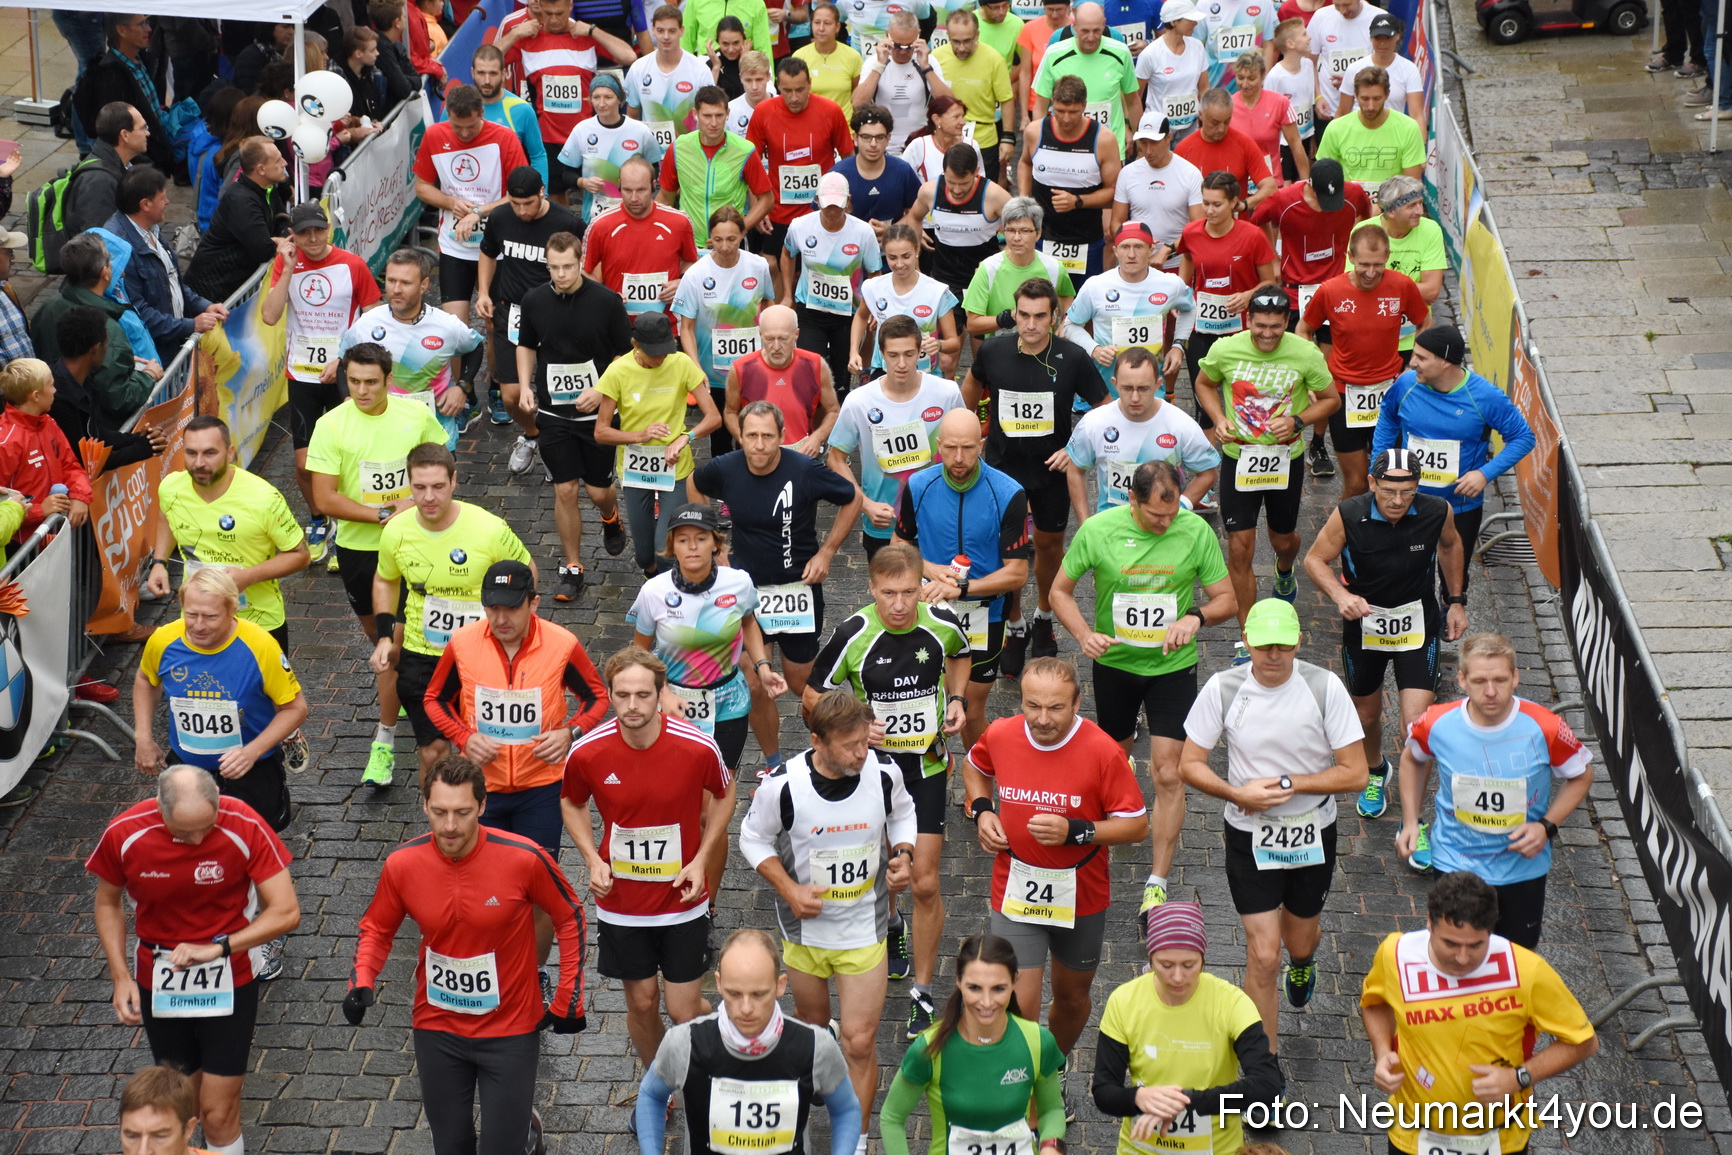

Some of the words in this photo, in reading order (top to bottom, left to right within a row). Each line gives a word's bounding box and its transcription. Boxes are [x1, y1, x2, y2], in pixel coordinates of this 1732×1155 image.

[1222, 33, 1254, 49] 2077
[546, 85, 579, 99] 2089
[1166, 100, 1198, 118] 3092
[656, 130, 673, 147] 69
[784, 173, 819, 191] 2546
[503, 240, 550, 263] THUL
[1052, 242, 1080, 259] 259
[1062, 262, 1076, 270] rice
[627, 284, 665, 301] 2007
[812, 280, 849, 301] 3095
[295, 310, 313, 318] AUFEN
[328, 310, 344, 318] HERZ
[1205, 321, 1232, 330] Christine
[1129, 327, 1149, 344] 39
[717, 338, 757, 355] 3061
[306, 347, 328, 364] 78
[553, 374, 594, 393] 2851
[1231, 360, 1300, 390] HELFER
[1011, 402, 1045, 420] 182
[1357, 413, 1381, 422] Christi
[1015, 423, 1040, 431] Daniel
[883, 433, 918, 455] 100
[629, 454, 670, 472] 2287
[887, 455, 920, 468] Christian
[1248, 456, 1282, 473] 292
[1417, 449, 1448, 469] 245
[372, 469, 407, 491] 337
[641, 474, 658, 484] Gabi
[1112, 472, 1132, 490] 24
[1246, 476, 1280, 486] Ferdinand
[381, 492, 401, 502] Felix
[217, 532, 237, 541] Partl
[783, 511, 795, 569] RALONE
[761, 593, 809, 615] 2206
[428, 611, 482, 632] 2917
[770, 618, 801, 627] Thomas
[1126, 607, 1166, 629] 612
[1376, 615, 1413, 636] 308
[1379, 636, 1409, 646] Oswald
[893, 676, 920, 689] DAV
[872, 685, 938, 702] Röthenbach
[482, 701, 537, 725] 3106
[686, 702, 710, 720] 63
[178, 711, 235, 735] 3048
[884, 713, 927, 735] 235
[487, 726, 515, 738] Stefan
[886, 739, 926, 750] Reinhard
[999, 785, 1067, 807] NEUMARKT
[1475, 792, 1506, 814] 49
[827, 823, 872, 834] KLEBL
[1472, 815, 1508, 827] Markus
[1260, 823, 1317, 849] 2428
[625, 839, 668, 861] 117
[1268, 851, 1310, 864] Reinhard
[631, 865, 662, 876] Martin
[826, 859, 869, 886] 184
[832, 887, 863, 901] Rainer
[1025, 881, 1055, 904] 24
[160, 965, 226, 992] 2747
[431, 964, 492, 994] 2896
[170, 995, 217, 1008] Bernhard
[439, 992, 483, 1008] Christian
[1406, 1004, 1457, 1026] MAX
[1463, 996, 1524, 1018] BÖGL
[1004, 1067, 1030, 1082] AOK
[730, 1100, 782, 1129] 135
[728, 1133, 777, 1149] Christian
[1156, 1137, 1186, 1150] Anika
